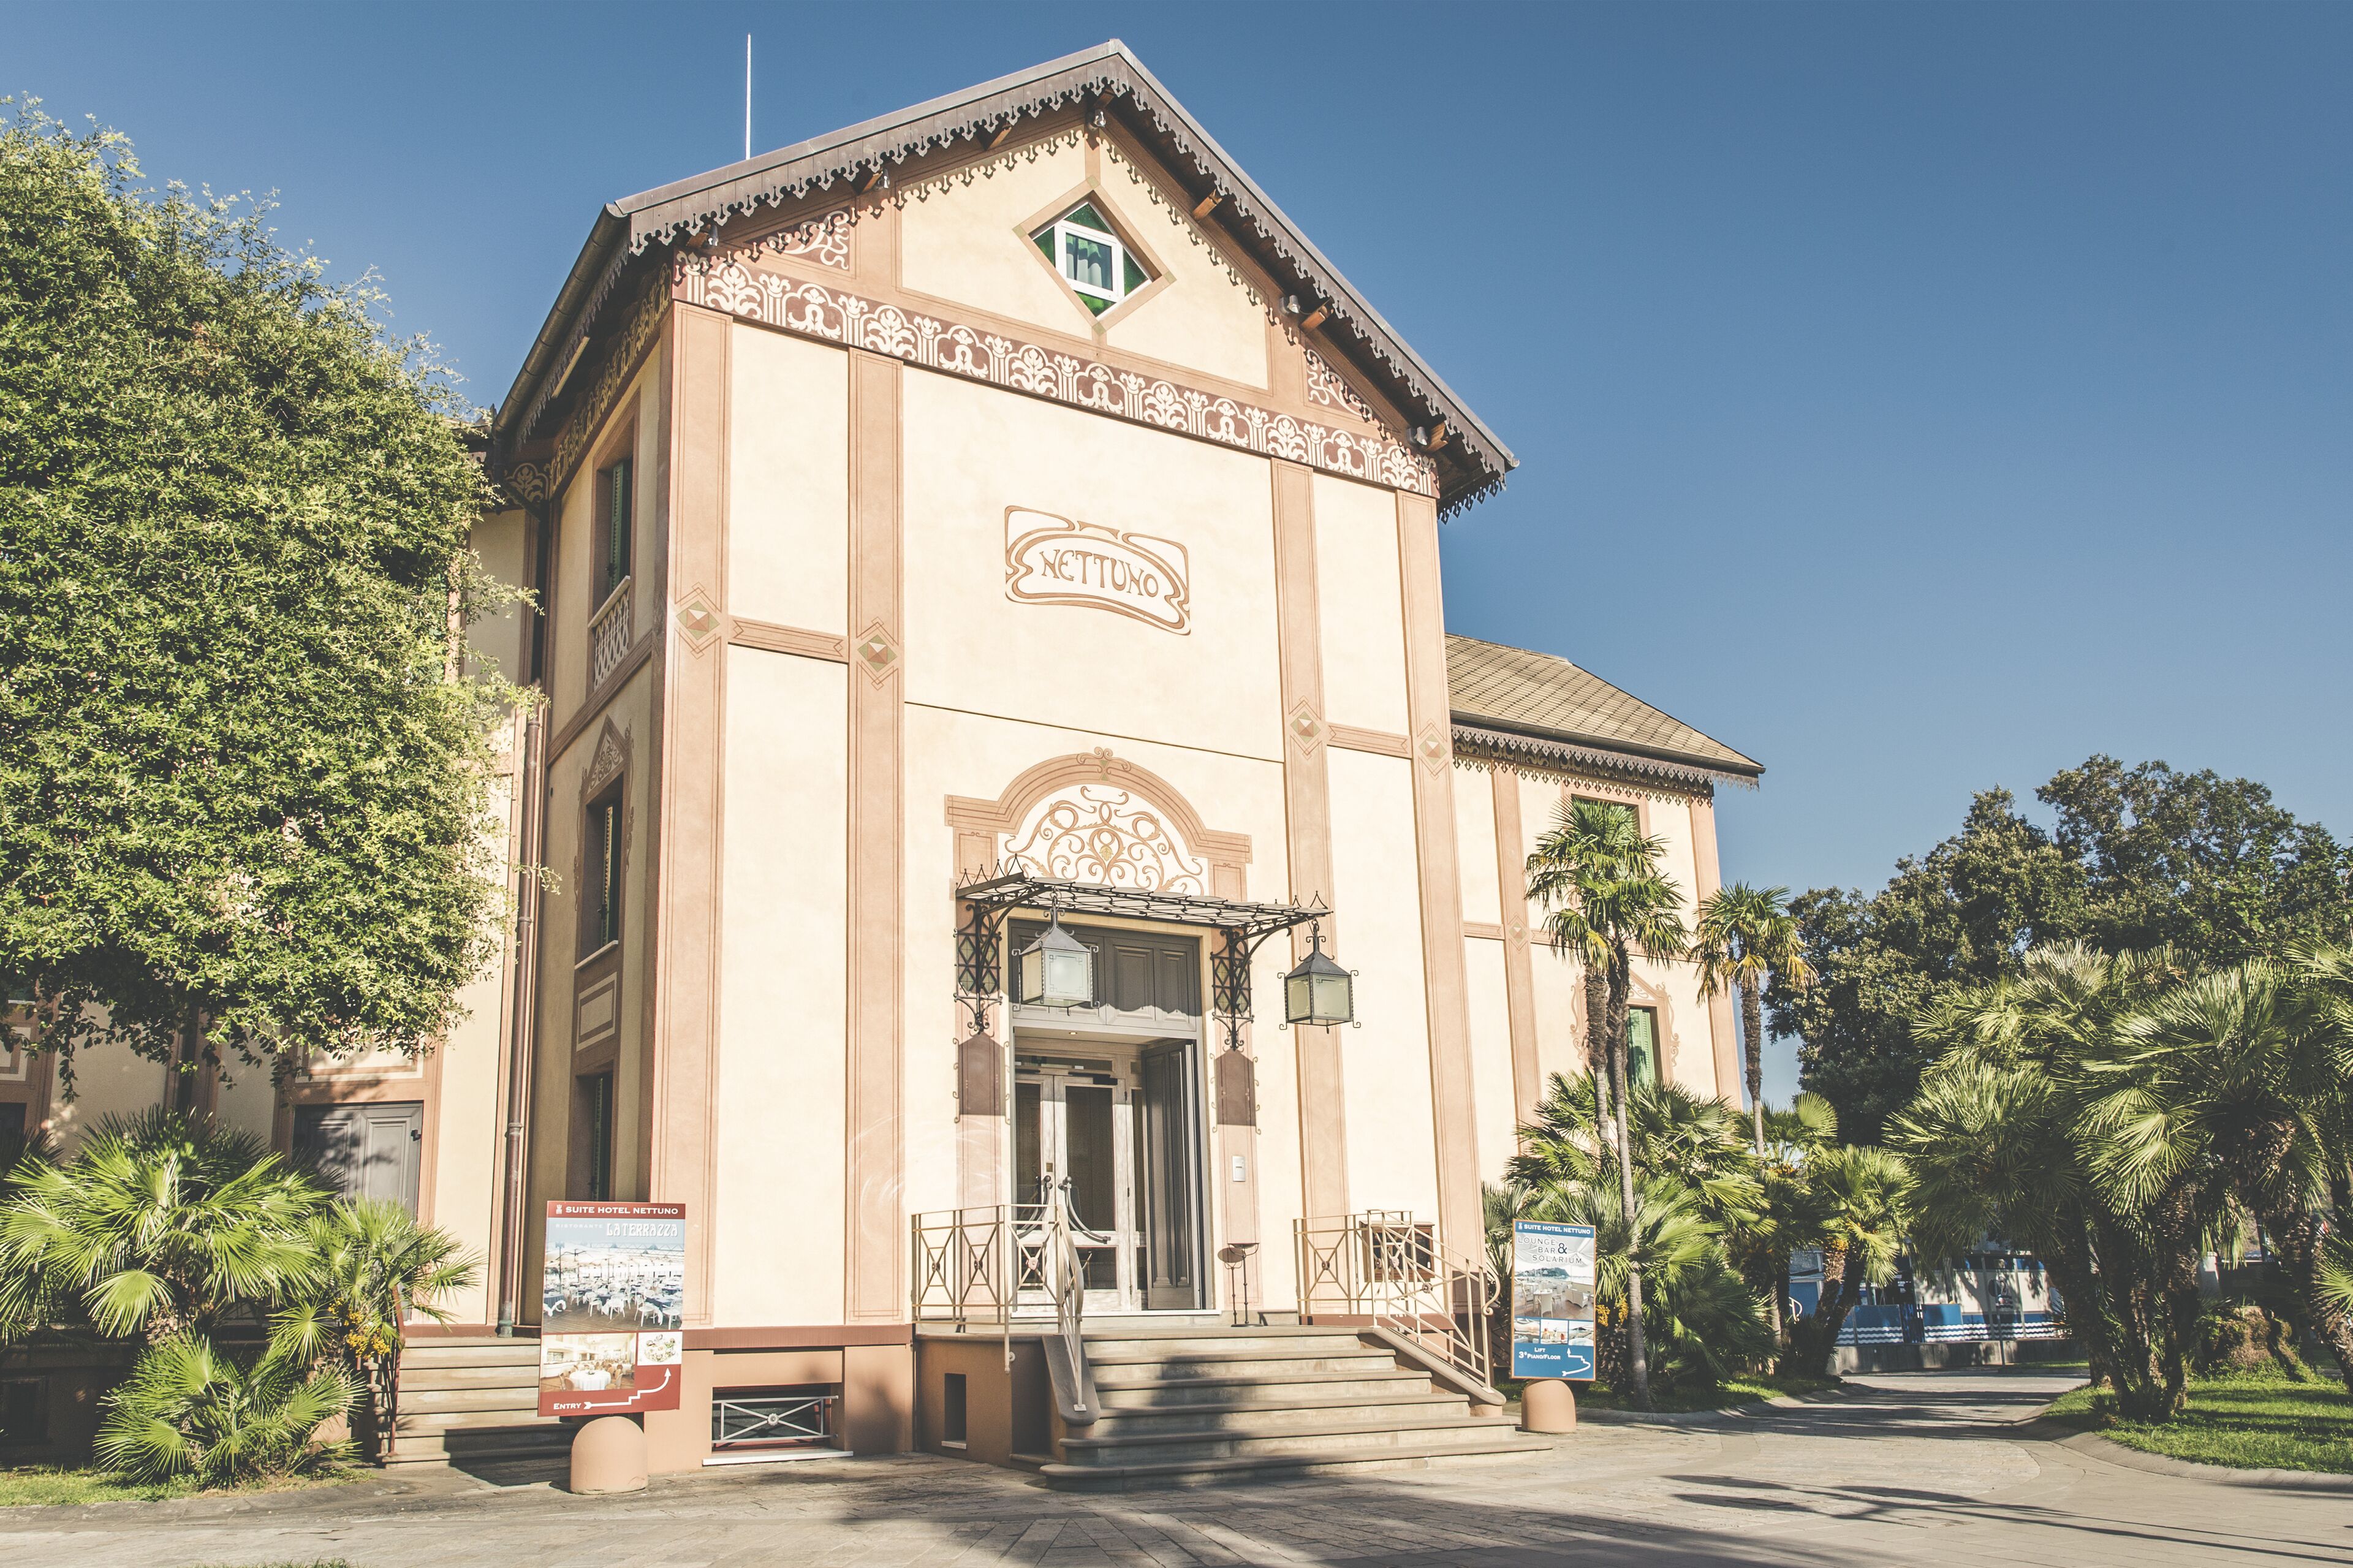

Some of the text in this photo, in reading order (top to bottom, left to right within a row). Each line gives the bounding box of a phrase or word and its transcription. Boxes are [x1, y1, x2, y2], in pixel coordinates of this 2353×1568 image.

[1039, 549, 1159, 597] NETTUNO
[607, 1223, 621, 1237] LA
[622, 1223, 678, 1237] TERRAZZA
[1518, 1237, 1556, 1245] LOUNGE
[1558, 1243, 1567, 1254] &
[1533, 1255, 1582, 1263] SOLARIUM
